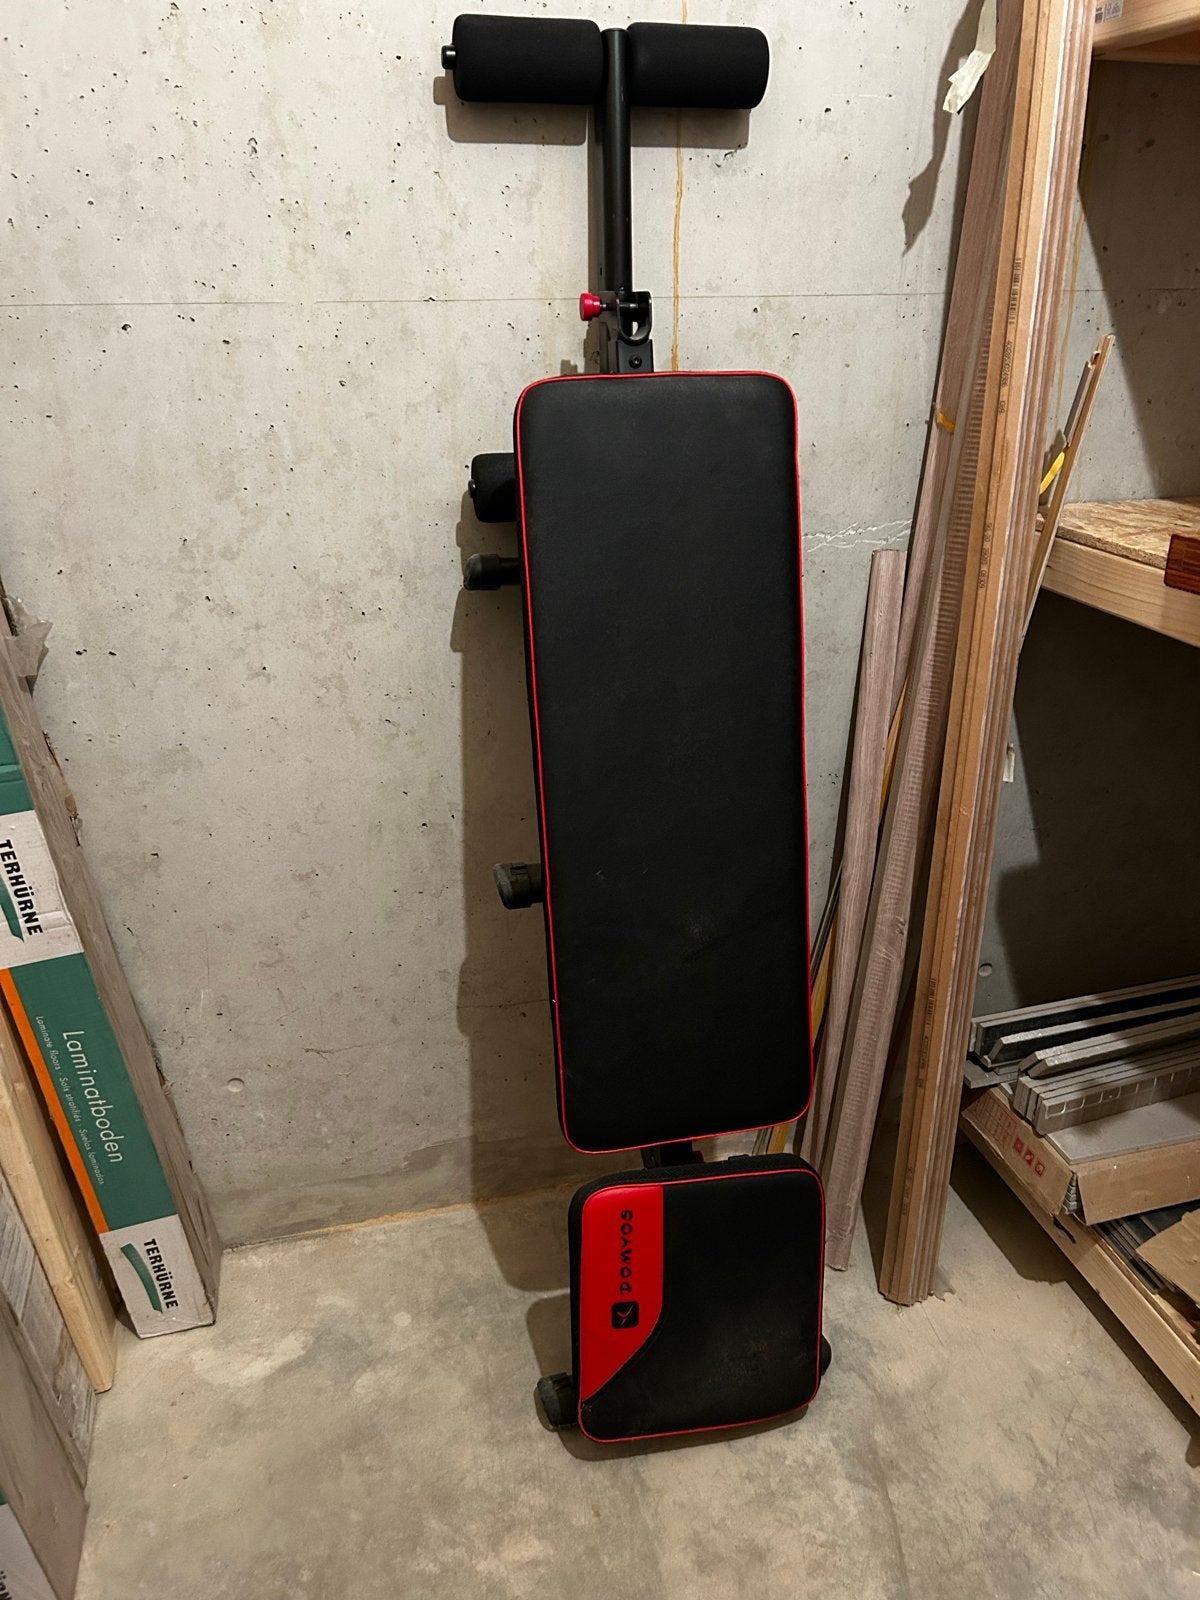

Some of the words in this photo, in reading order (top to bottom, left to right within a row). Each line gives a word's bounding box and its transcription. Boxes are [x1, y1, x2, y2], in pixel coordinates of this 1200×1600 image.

[0, 839, 43, 935] TERHÜRNE
[36, 1016, 52, 1049] Laminate
[51, 1050, 61, 1071] floors
[63, 1030, 124, 1163] Laminatboden
[144, 1239, 178, 1309] TERHÜRNE
[620, 1209, 634, 1295] DOMYOS
